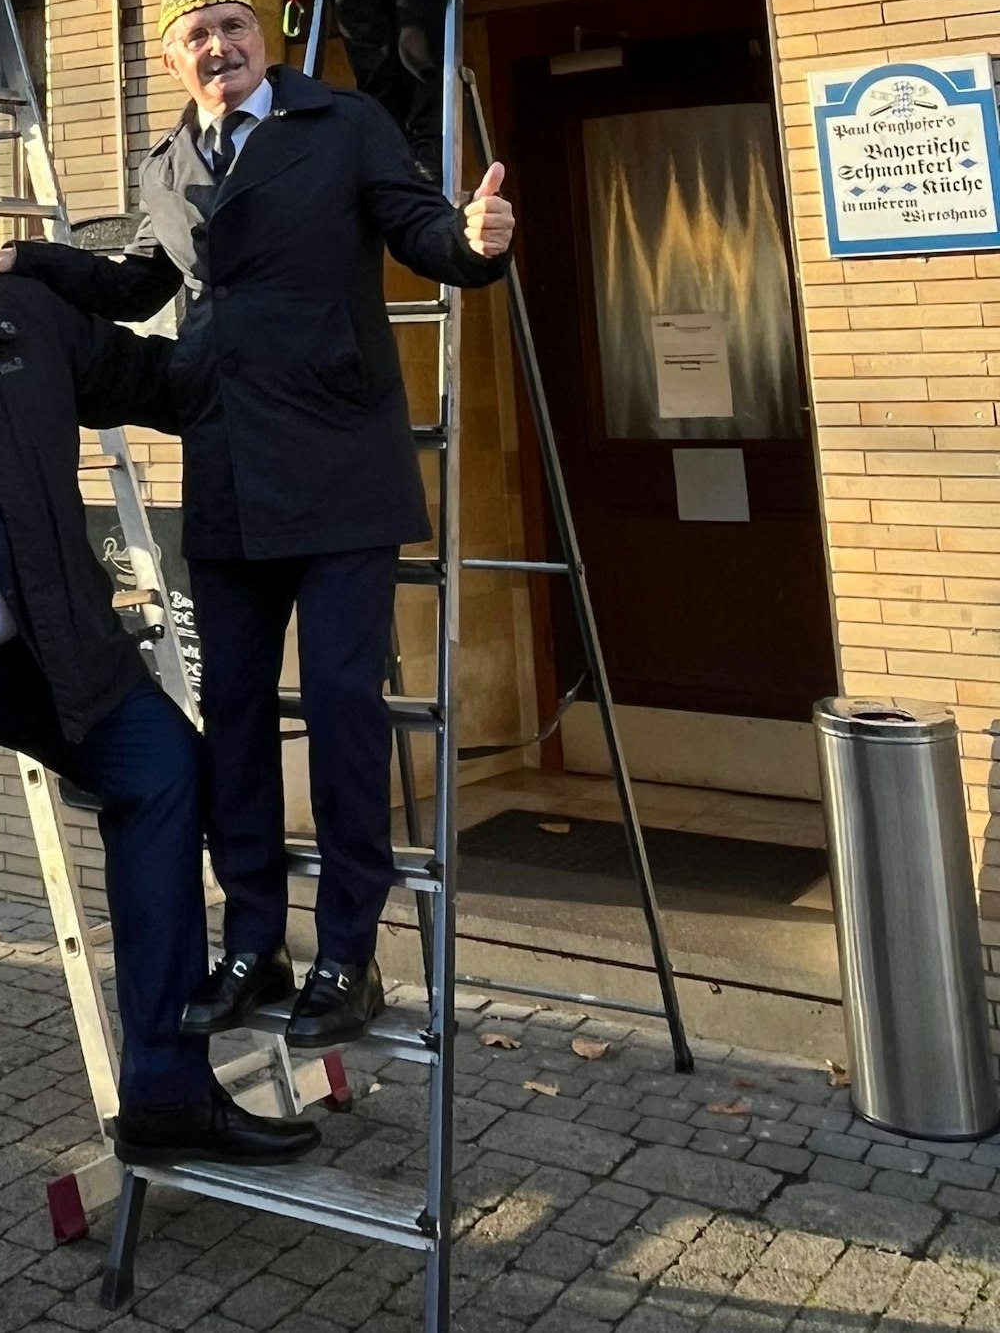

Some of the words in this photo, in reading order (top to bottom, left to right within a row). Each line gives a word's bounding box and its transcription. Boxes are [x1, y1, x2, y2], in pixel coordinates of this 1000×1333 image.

[833, 122, 870, 141] Paul
[863, 136, 971, 161] Bayerische
[838, 156, 953, 183] Schmankerl
[922, 175, 984, 196] Küche
[842, 200, 857, 213] in
[859, 196, 919, 212] unserem
[901, 205, 988, 223] Wirtshaus
